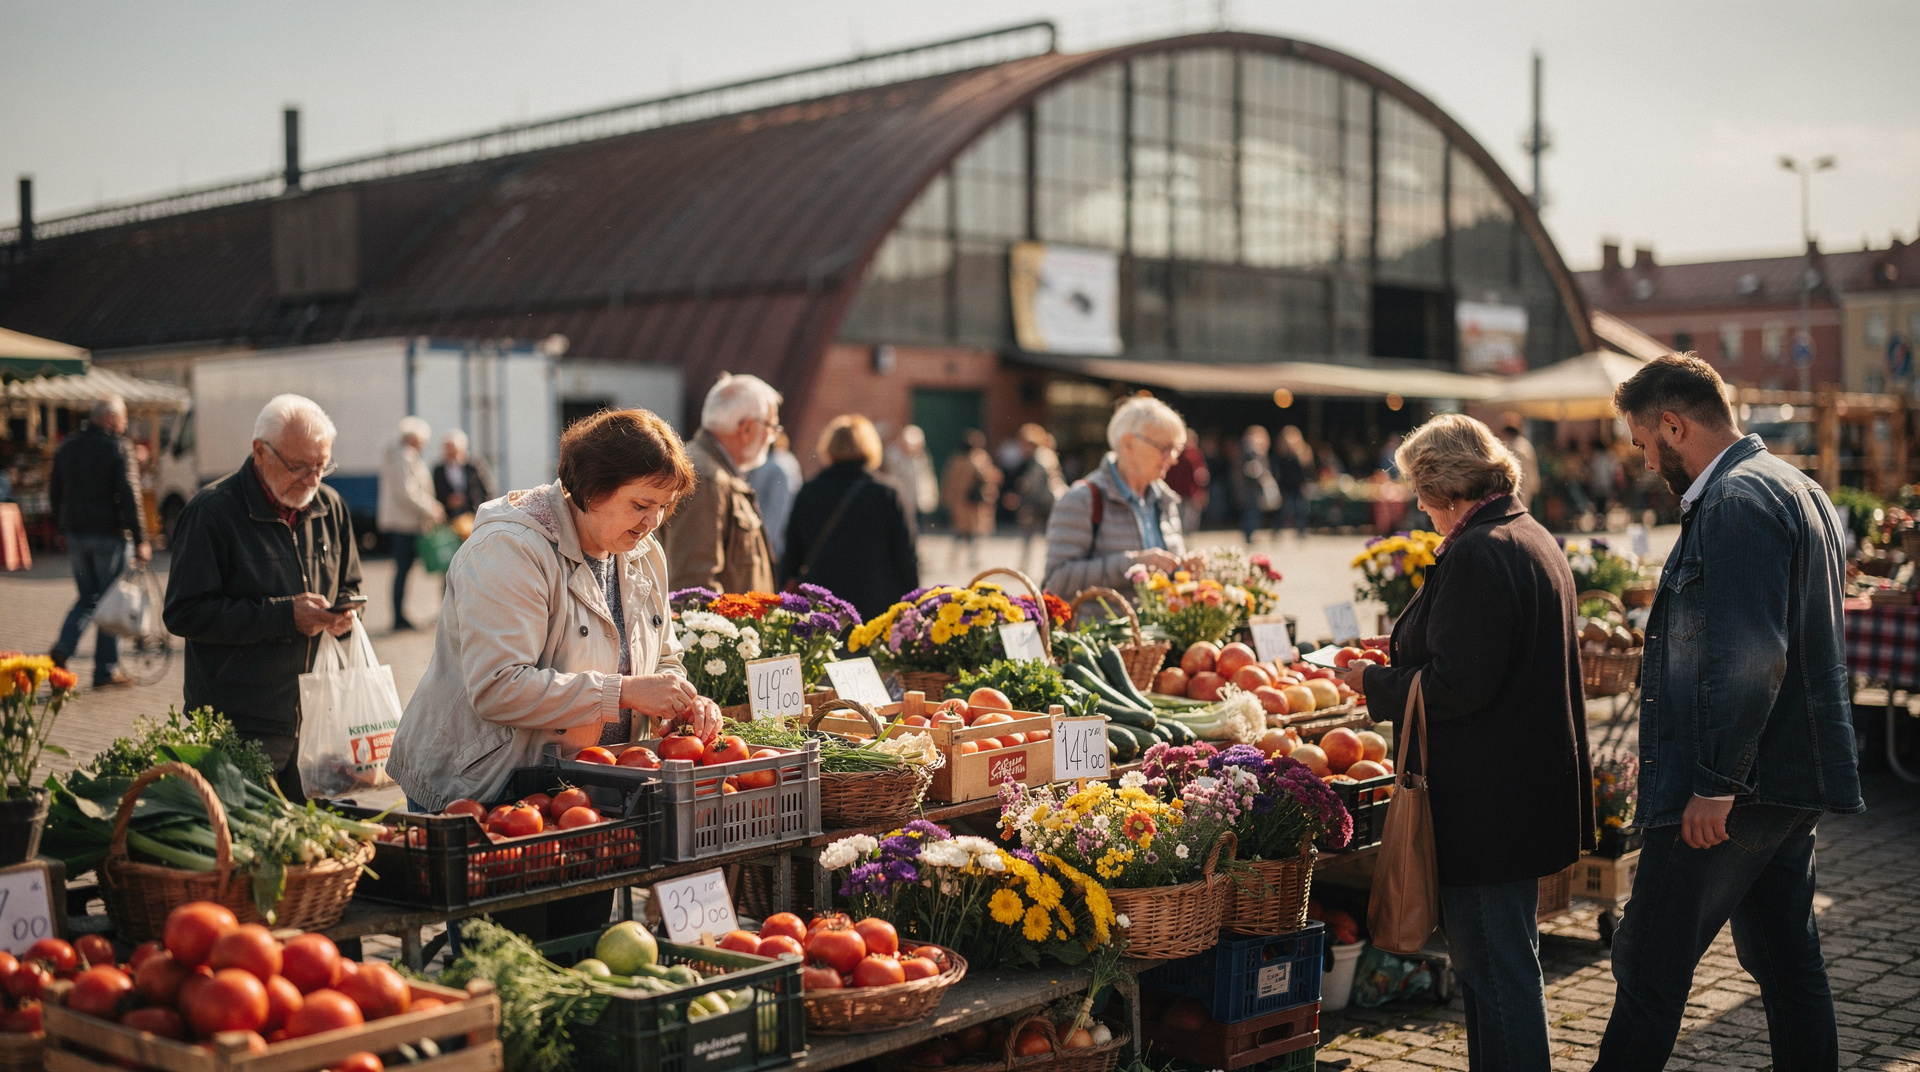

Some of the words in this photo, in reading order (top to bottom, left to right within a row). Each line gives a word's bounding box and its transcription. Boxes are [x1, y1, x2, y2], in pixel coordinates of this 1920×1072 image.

[757, 669, 781, 710] 49
[782, 691, 800, 708] 00
[1090, 753, 1106, 769] 00
[669, 885, 705, 933] 33
[708, 907, 729, 923] 00
[12, 915, 48, 941] 00
